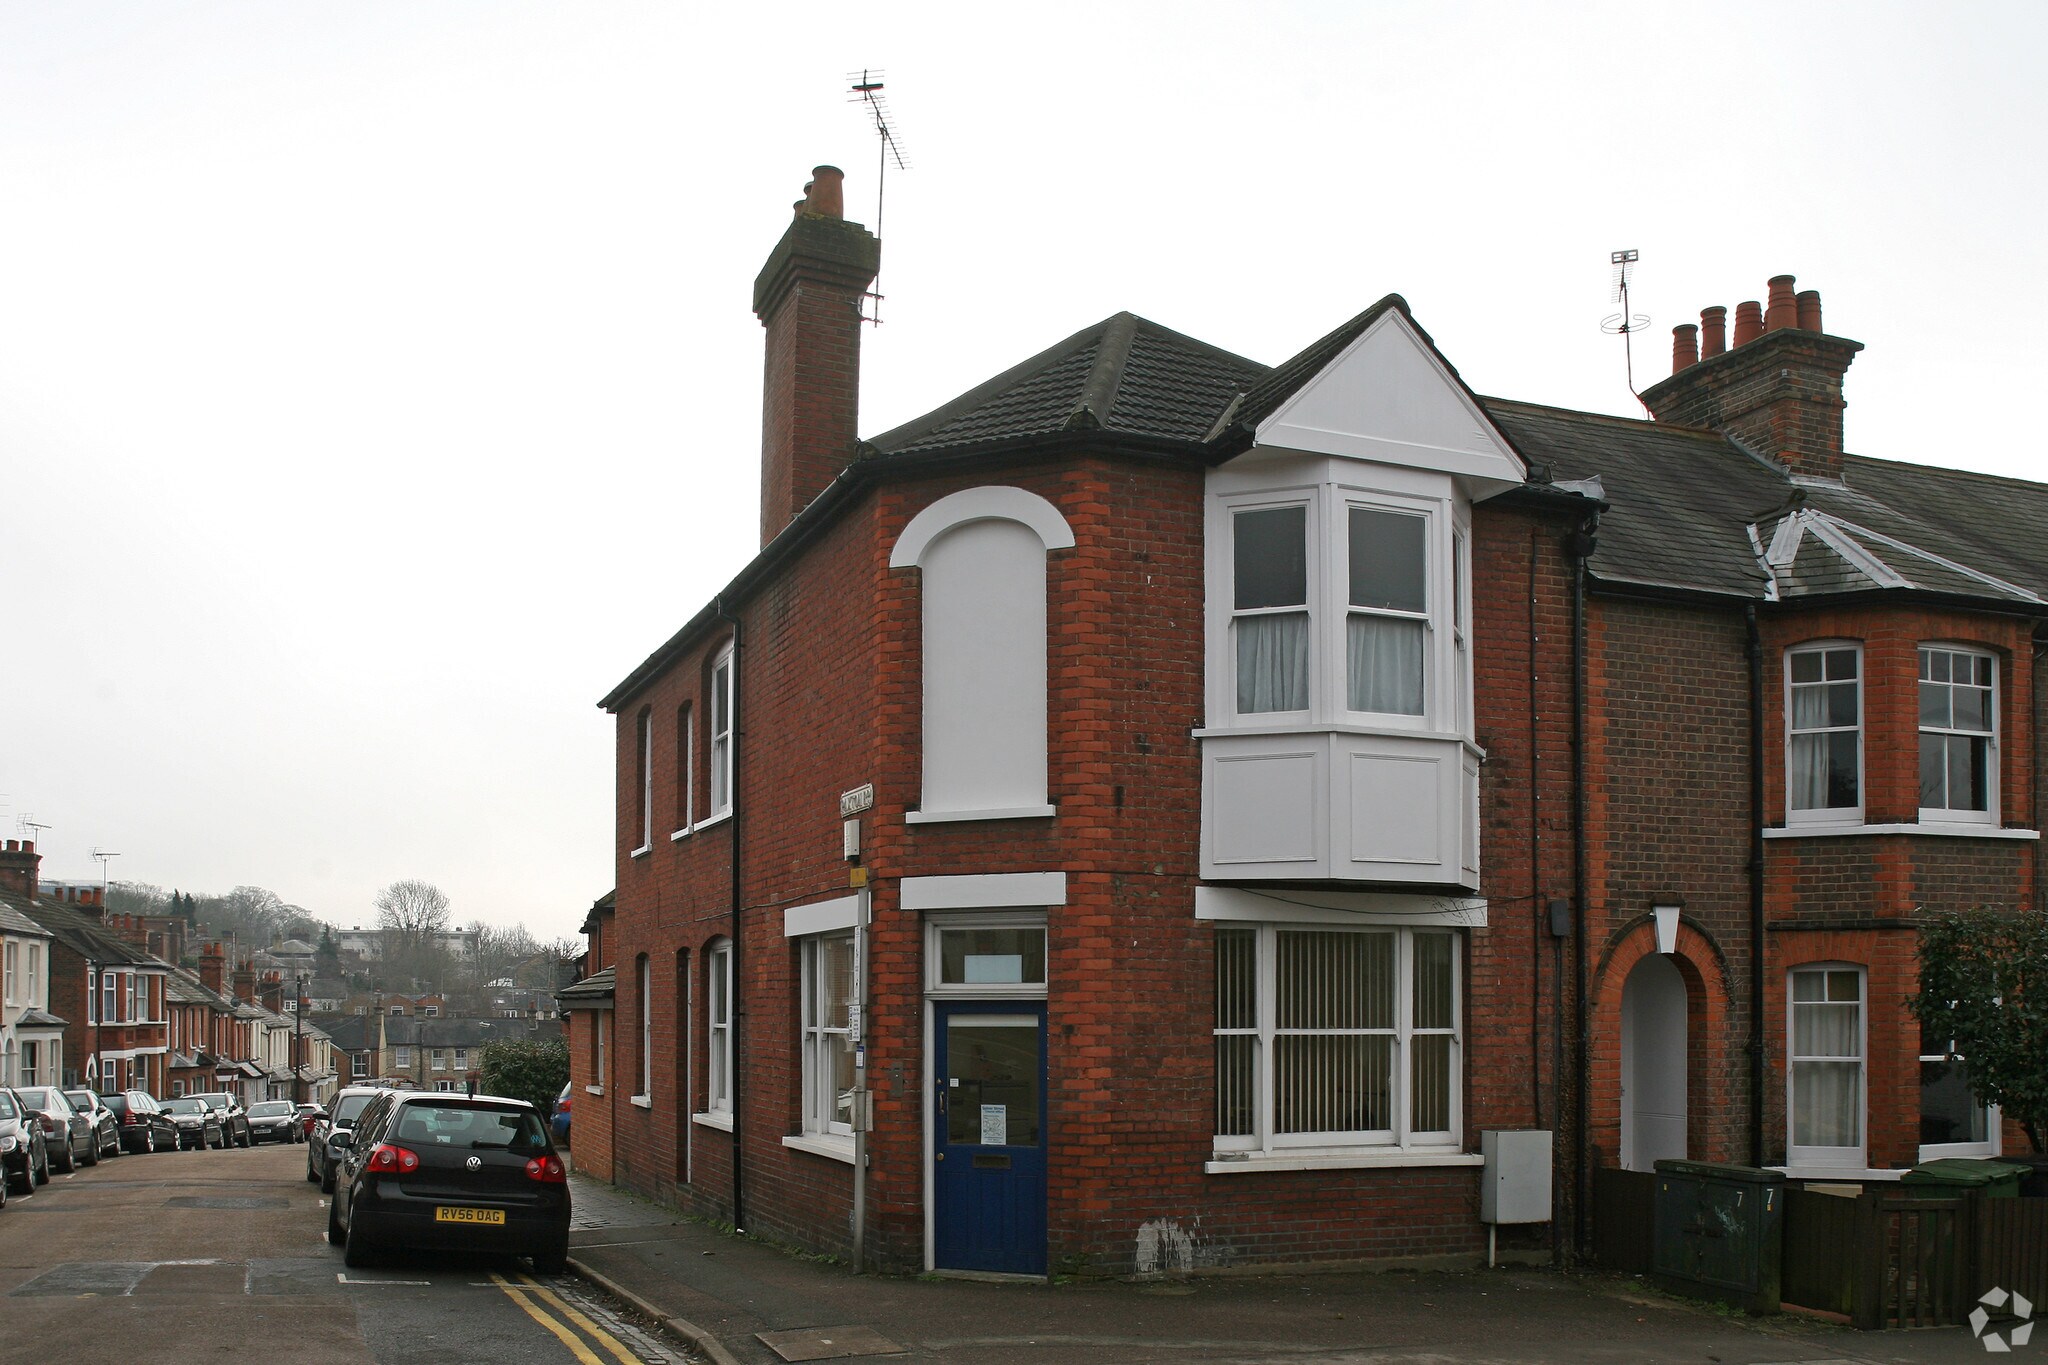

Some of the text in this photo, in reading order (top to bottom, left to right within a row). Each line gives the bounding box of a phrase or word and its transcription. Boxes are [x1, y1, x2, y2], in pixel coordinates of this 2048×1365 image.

[1766, 1188, 1774, 1204] 7
[441, 1208, 500, 1222] RV56 OAG
